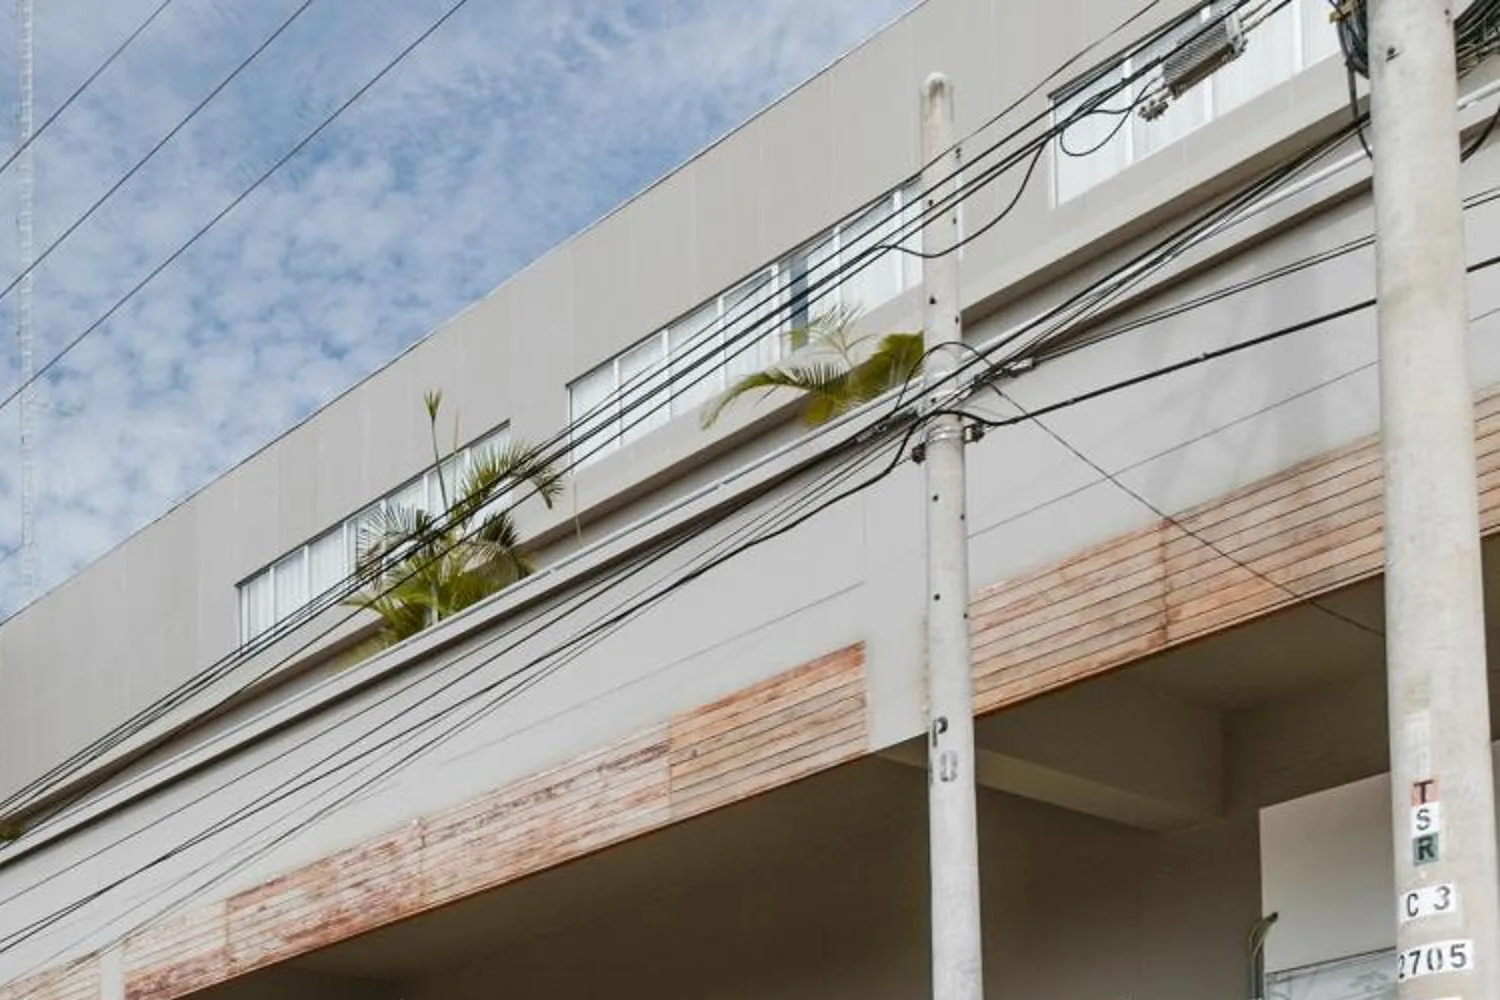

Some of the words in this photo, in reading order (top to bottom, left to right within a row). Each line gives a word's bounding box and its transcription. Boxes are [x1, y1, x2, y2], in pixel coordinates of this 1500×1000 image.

[1413, 780, 1434, 804] T
[1416, 809, 1431, 831] S
[1417, 835, 1434, 861] R
